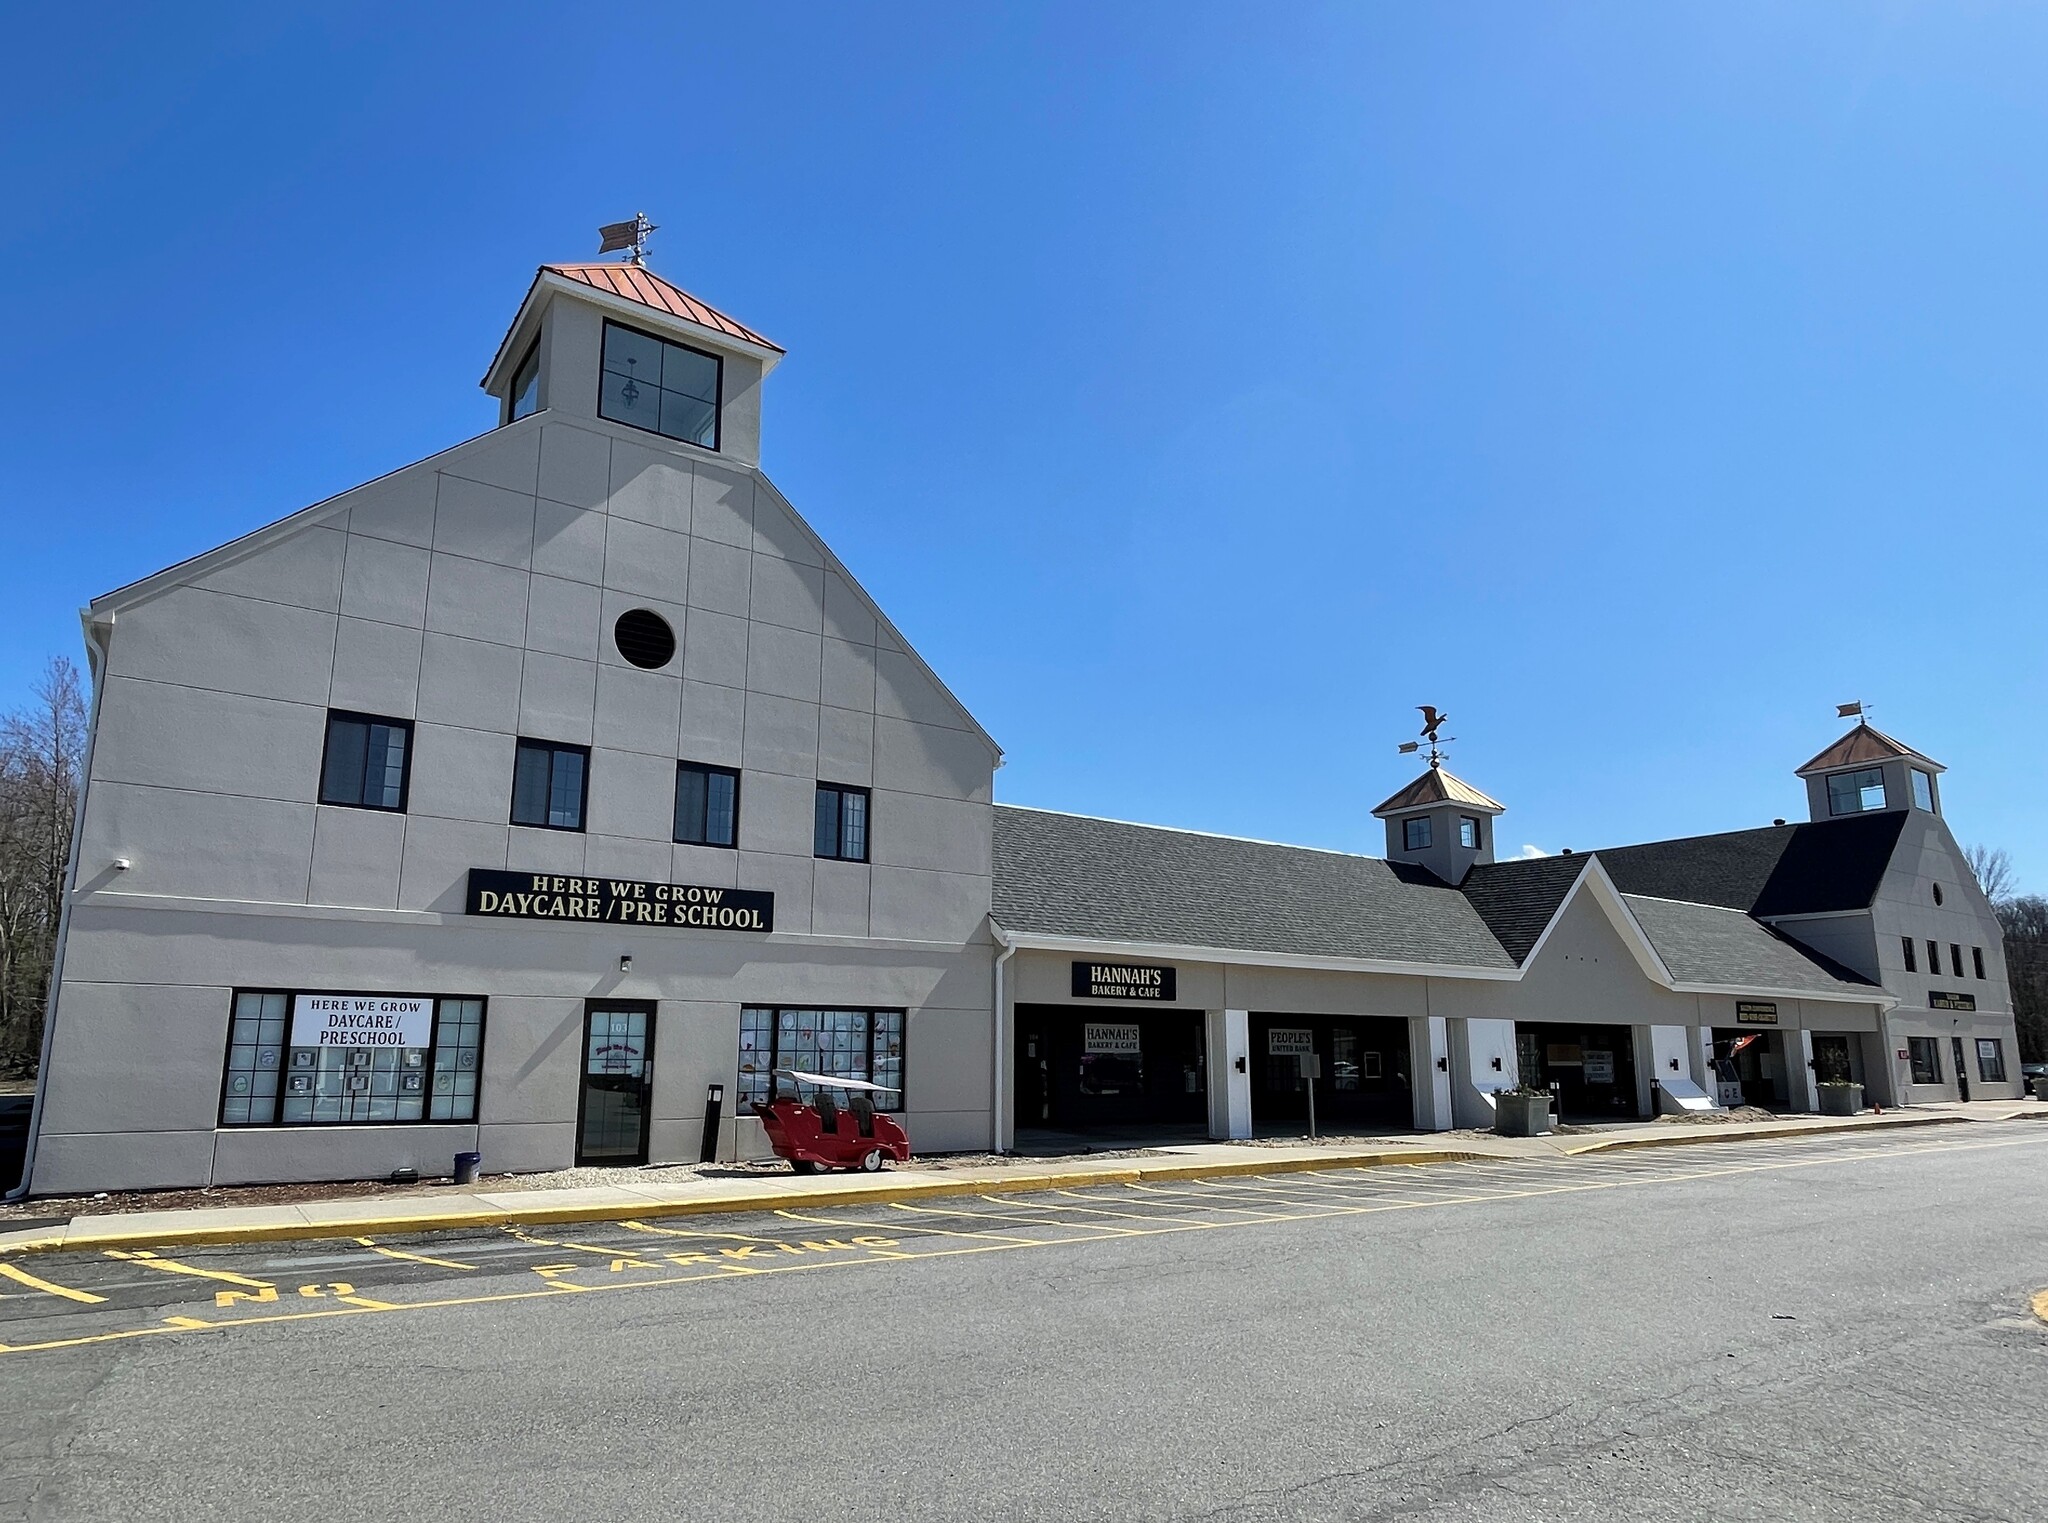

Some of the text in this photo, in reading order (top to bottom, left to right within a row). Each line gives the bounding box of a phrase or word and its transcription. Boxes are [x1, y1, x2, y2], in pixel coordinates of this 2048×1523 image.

[532, 875, 724, 904] HERE WE GROW
[479, 890, 601, 919] DAYCARE
[673, 904, 764, 929] SCHOOL
[1091, 966, 1161, 985] HANNAH'S
[1091, 985, 1161, 998] BAKERY & CAFE
[310, 1000, 421, 1013] HERE WE GROW
[610, 1023, 628, 1033] 103
[1087, 1028, 1138, 1040] HANNAH'S
[319, 1031, 406, 1045] PRESCHOOL
[1271, 1032, 1311, 1043] PEOPLE'S
[1088, 1041, 1113, 1049] BAKERY
[215, 1236, 900, 1308] NO PARKING
